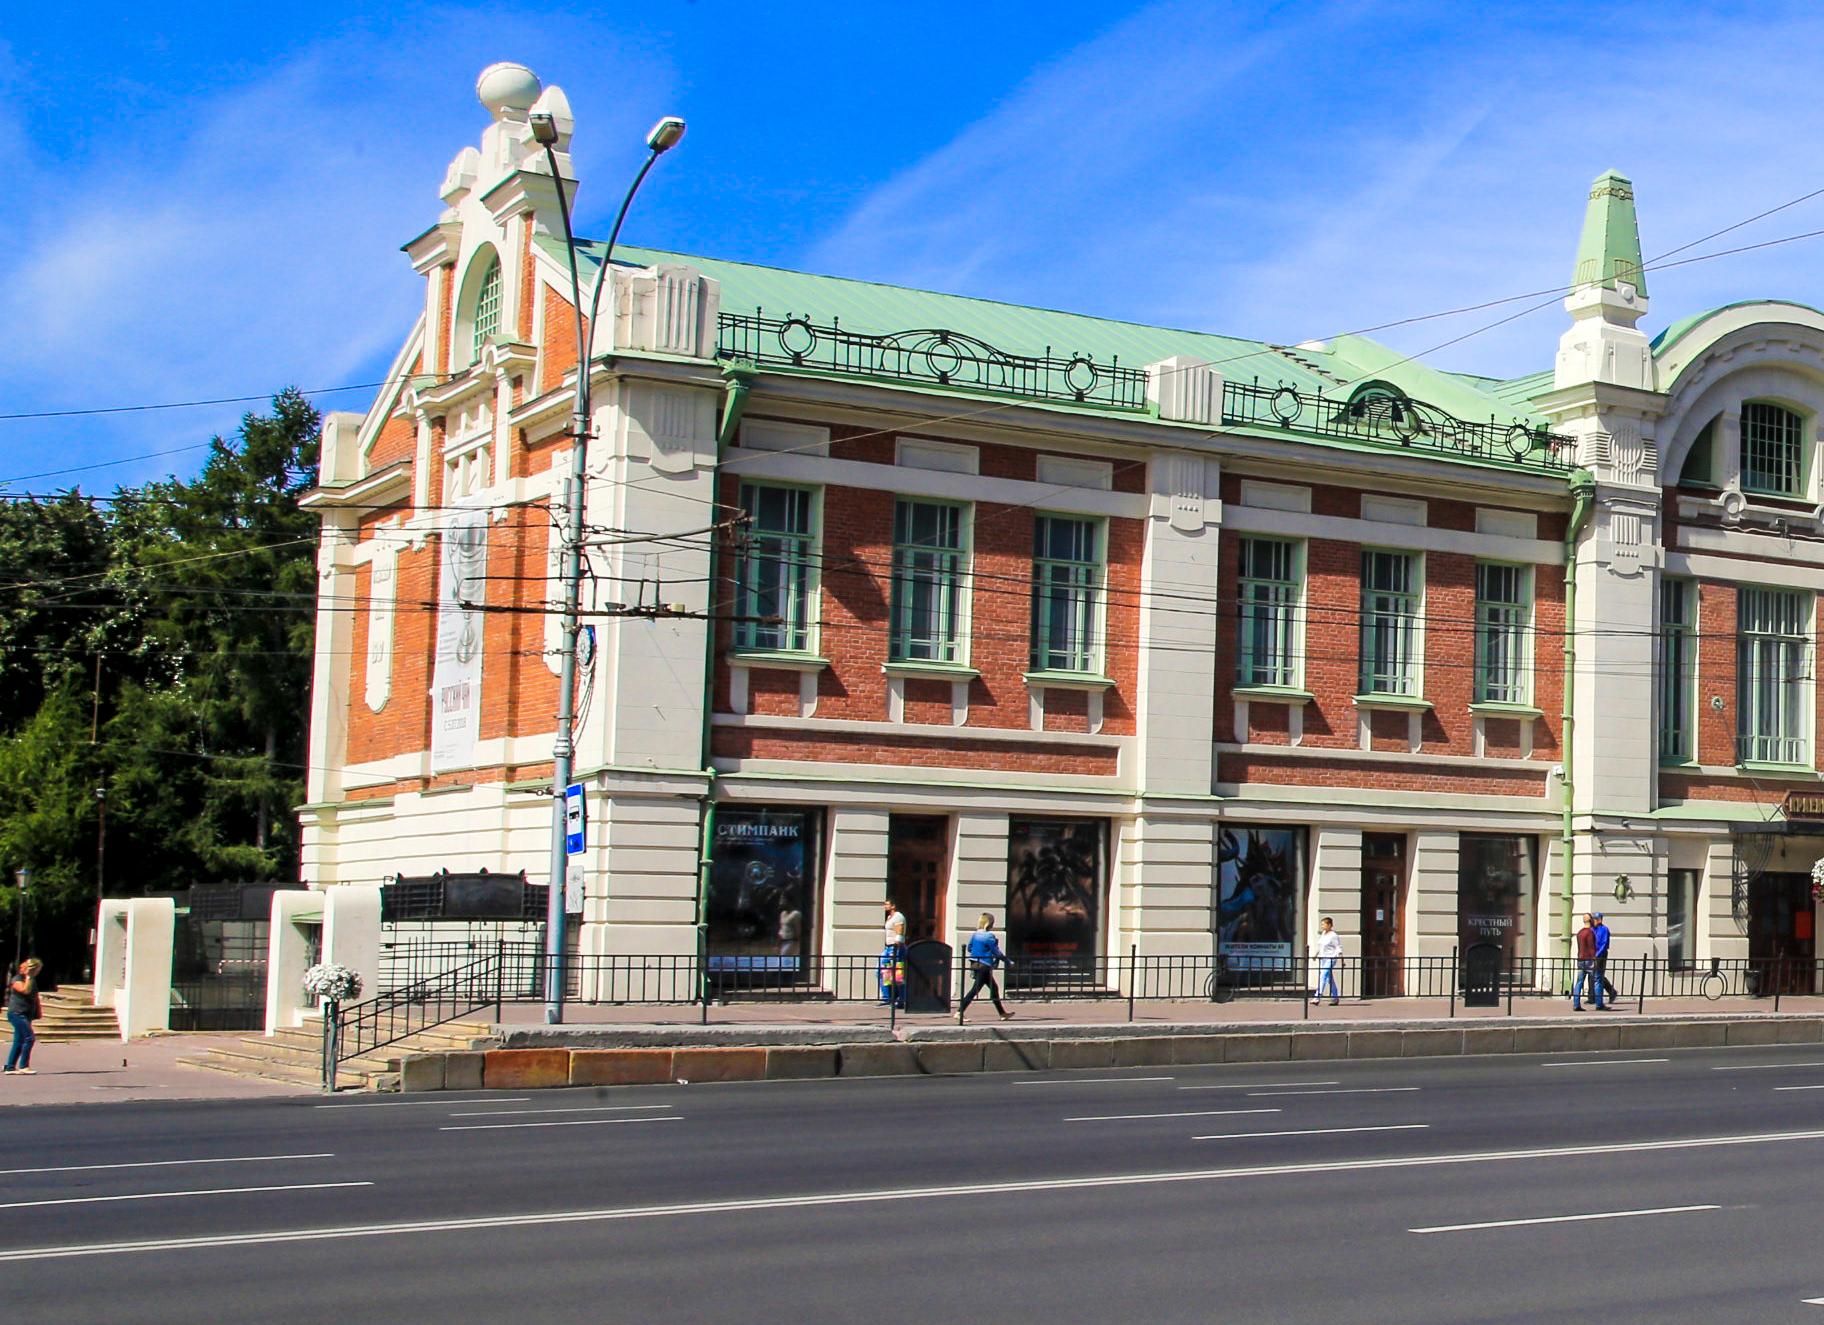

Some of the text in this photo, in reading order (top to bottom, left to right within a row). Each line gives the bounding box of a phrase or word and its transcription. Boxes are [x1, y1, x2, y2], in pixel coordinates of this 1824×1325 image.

[718, 823, 799, 837] СТИМПАНК
[1467, 917, 1513, 927] КРЕСТНЫЙ
[1480, 927, 1502, 937] ПУТЬ
